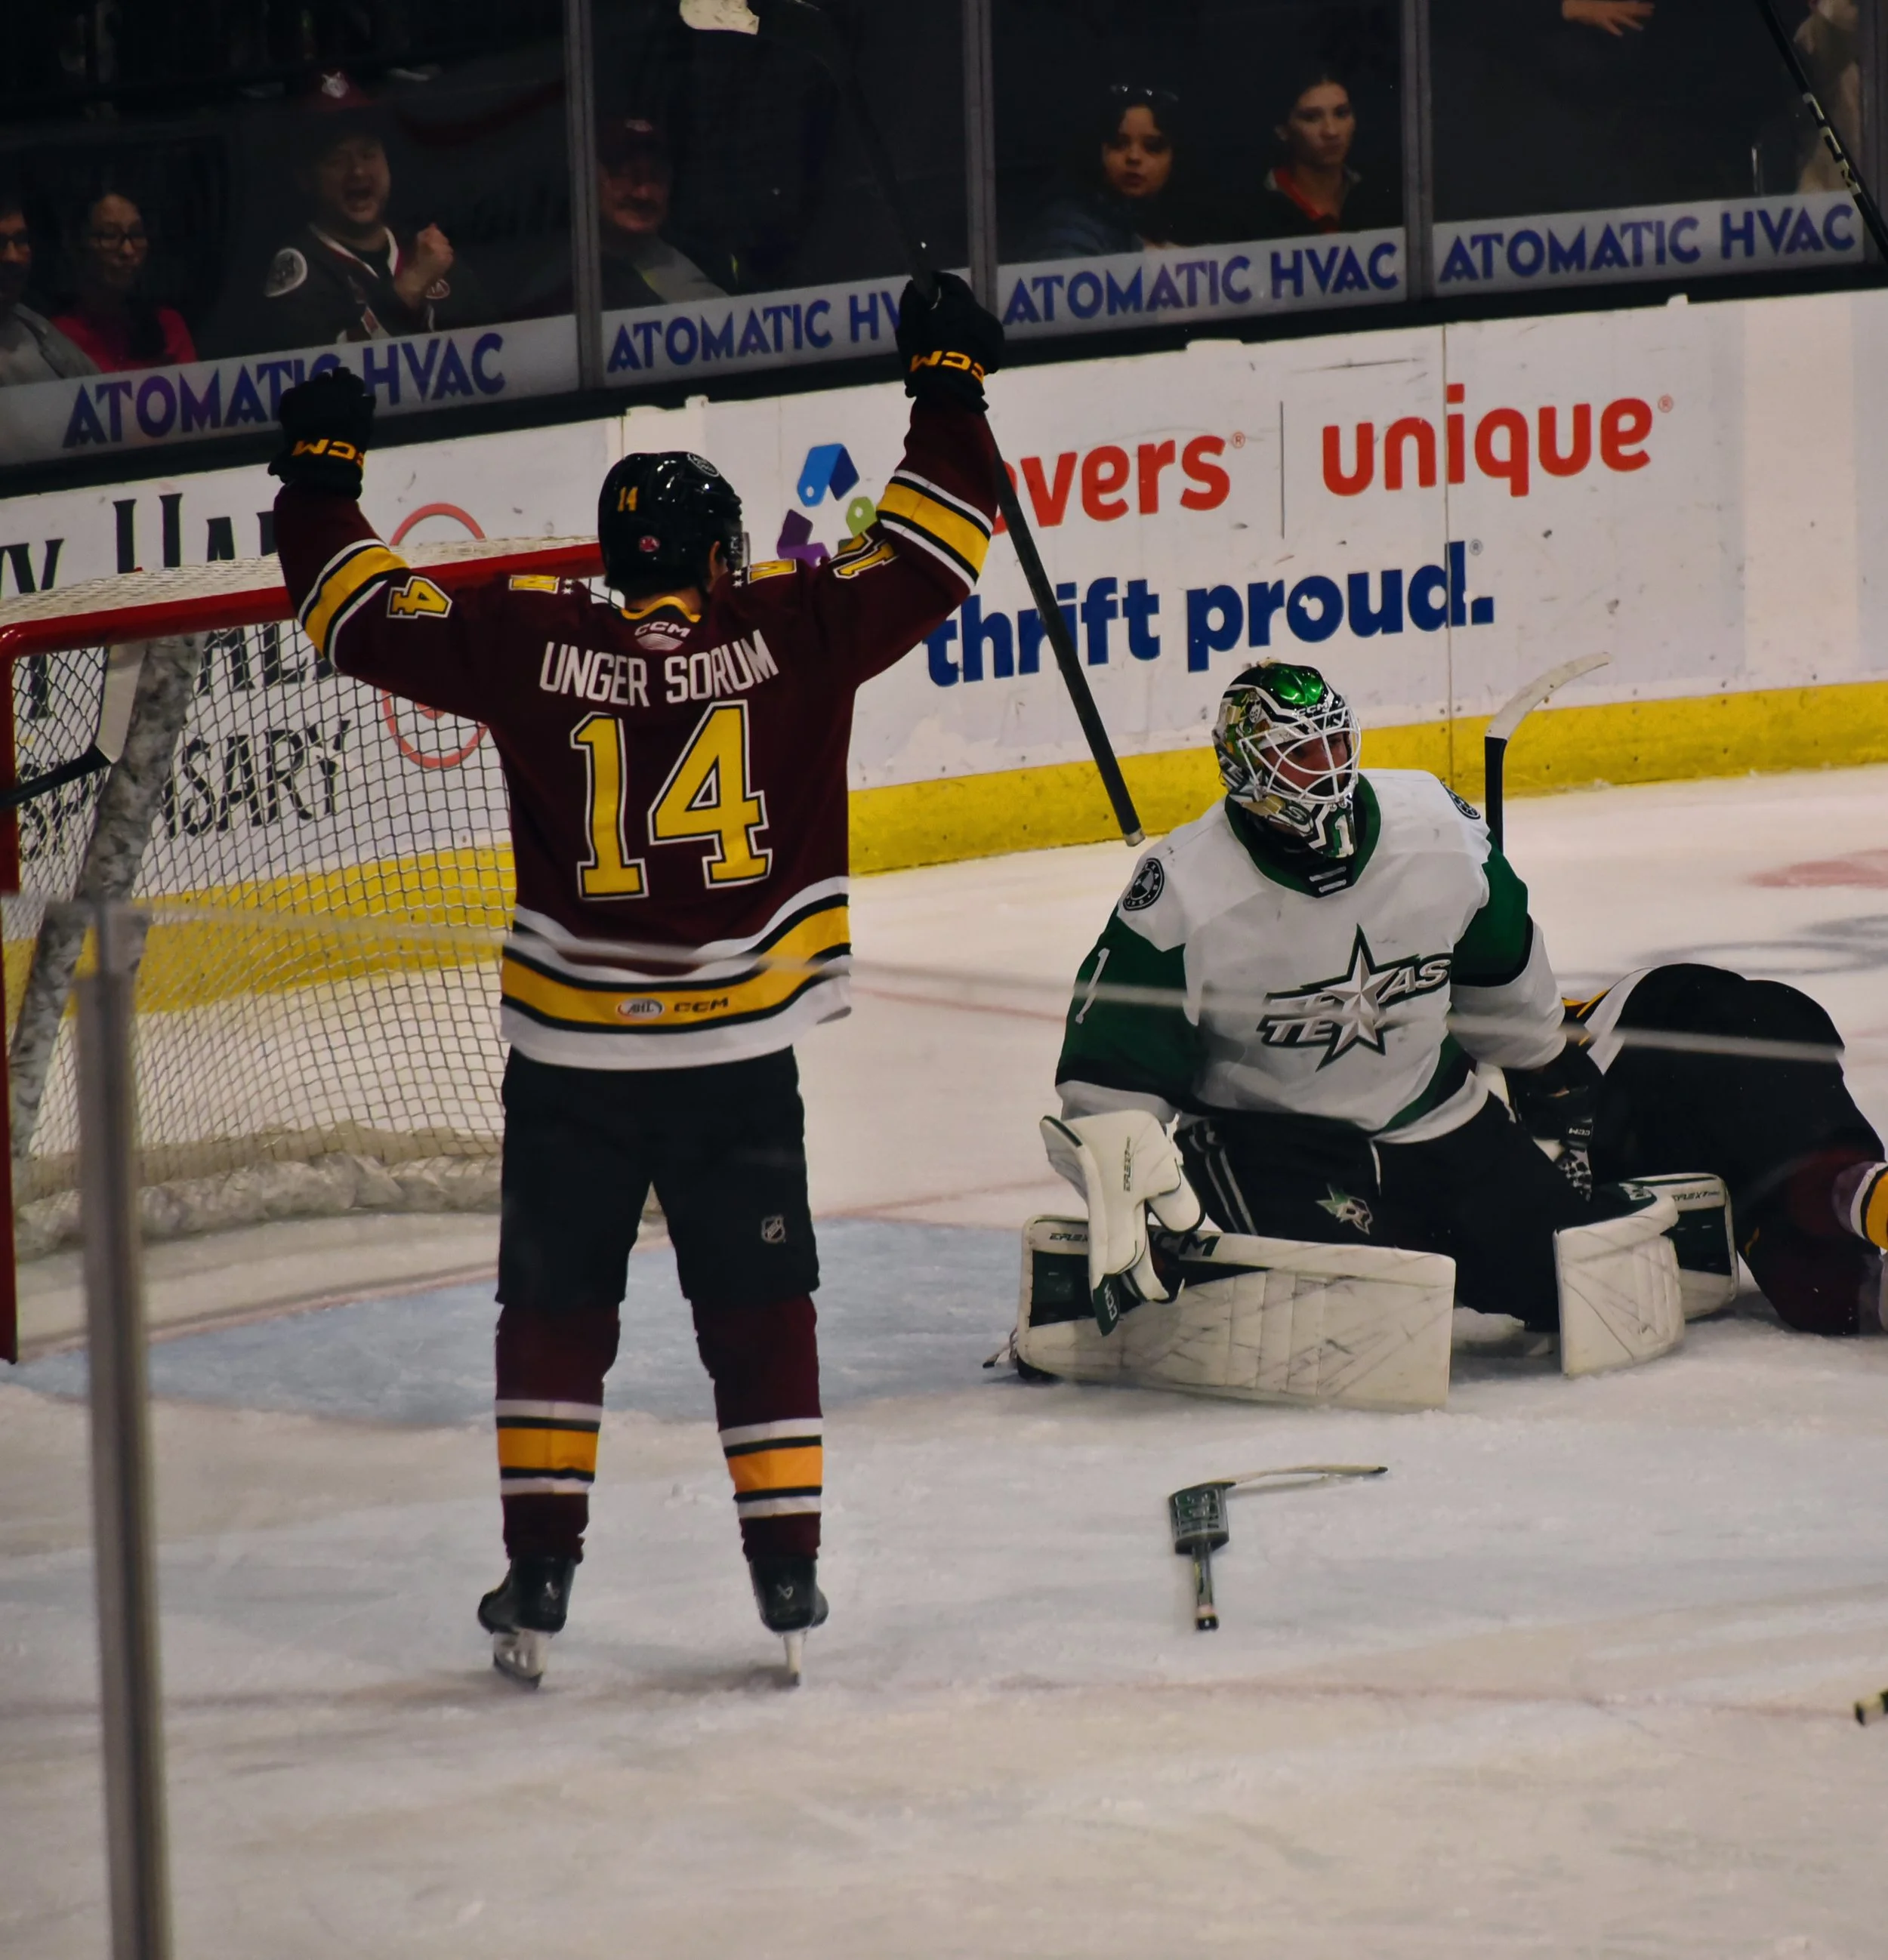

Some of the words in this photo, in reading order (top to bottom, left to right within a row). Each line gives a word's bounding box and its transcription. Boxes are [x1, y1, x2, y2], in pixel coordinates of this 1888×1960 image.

[1439, 217, 1700, 282] ATOMATIC
[1721, 205, 1856, 260] HVAC
[1002, 256, 1251, 325] ATOMATIC
[1271, 242, 1399, 300] HVAC
[363, 332, 504, 406] HVAC
[607, 299, 832, 373] ATOMATIC
[849, 291, 901, 344] HV
[617, 485, 639, 509] 14
[992, 435, 1230, 535] vers
[1322, 384, 1652, 497] unique
[386, 575, 453, 619] 4
[634, 621, 690, 638] CCM
[921, 577, 1161, 688] thrift
[1187, 541, 1494, 673] proud.
[539, 640, 650, 707] UNGER
[665, 628, 780, 704] SORUM
[570, 699, 773, 901] 14
[674, 997, 729, 1012] CCM
[1075, 947, 1111, 1025] 1
